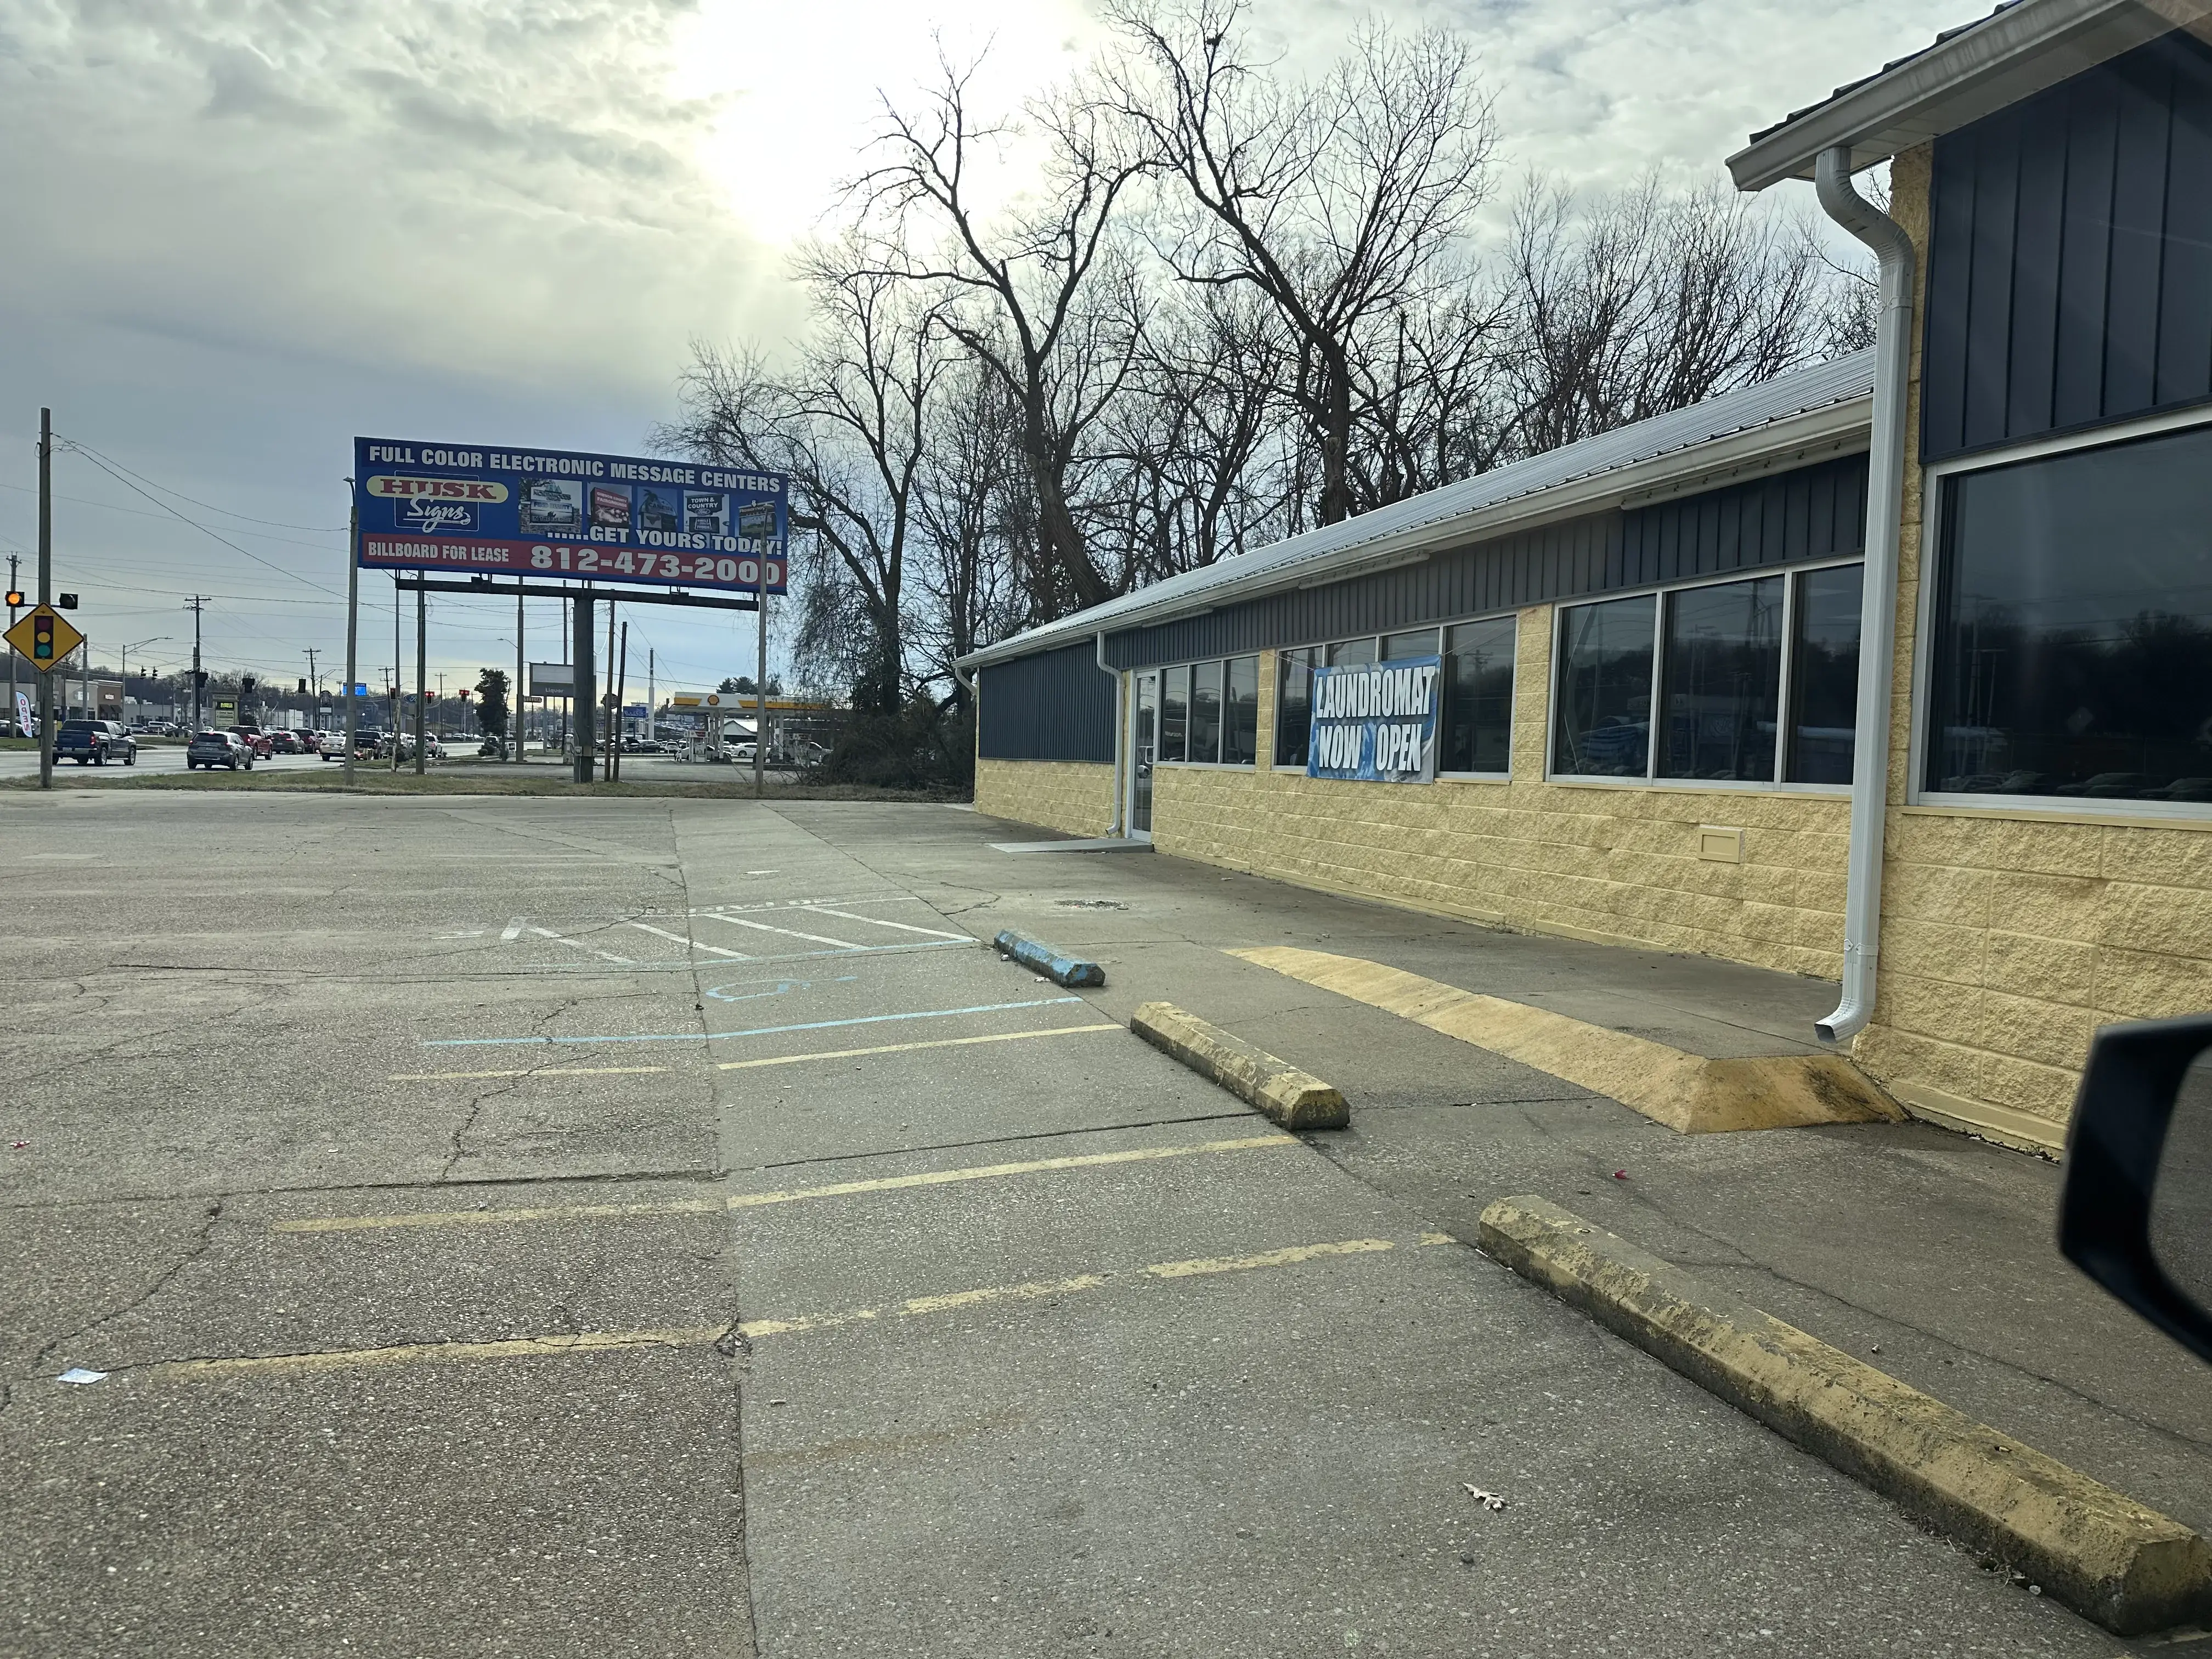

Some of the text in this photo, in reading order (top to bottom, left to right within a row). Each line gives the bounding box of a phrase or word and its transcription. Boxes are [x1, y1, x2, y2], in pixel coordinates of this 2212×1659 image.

[369, 445, 780, 493] FULL COLOR ELECTRONIC MESSAGE CENTERS
[380, 479, 497, 500] HUSK
[407, 493, 471, 533] Signs
[368, 541, 509, 562] BILLBOARD FOR LEASE
[635, 529, 706, 550] YOURS
[711, 535, 782, 555] TODAY!
[531, 545, 780, 585] 812-473-2000
[1316, 665, 1436, 719] LAUNDROMAT
[1319, 723, 1422, 771] NOW OPEN
